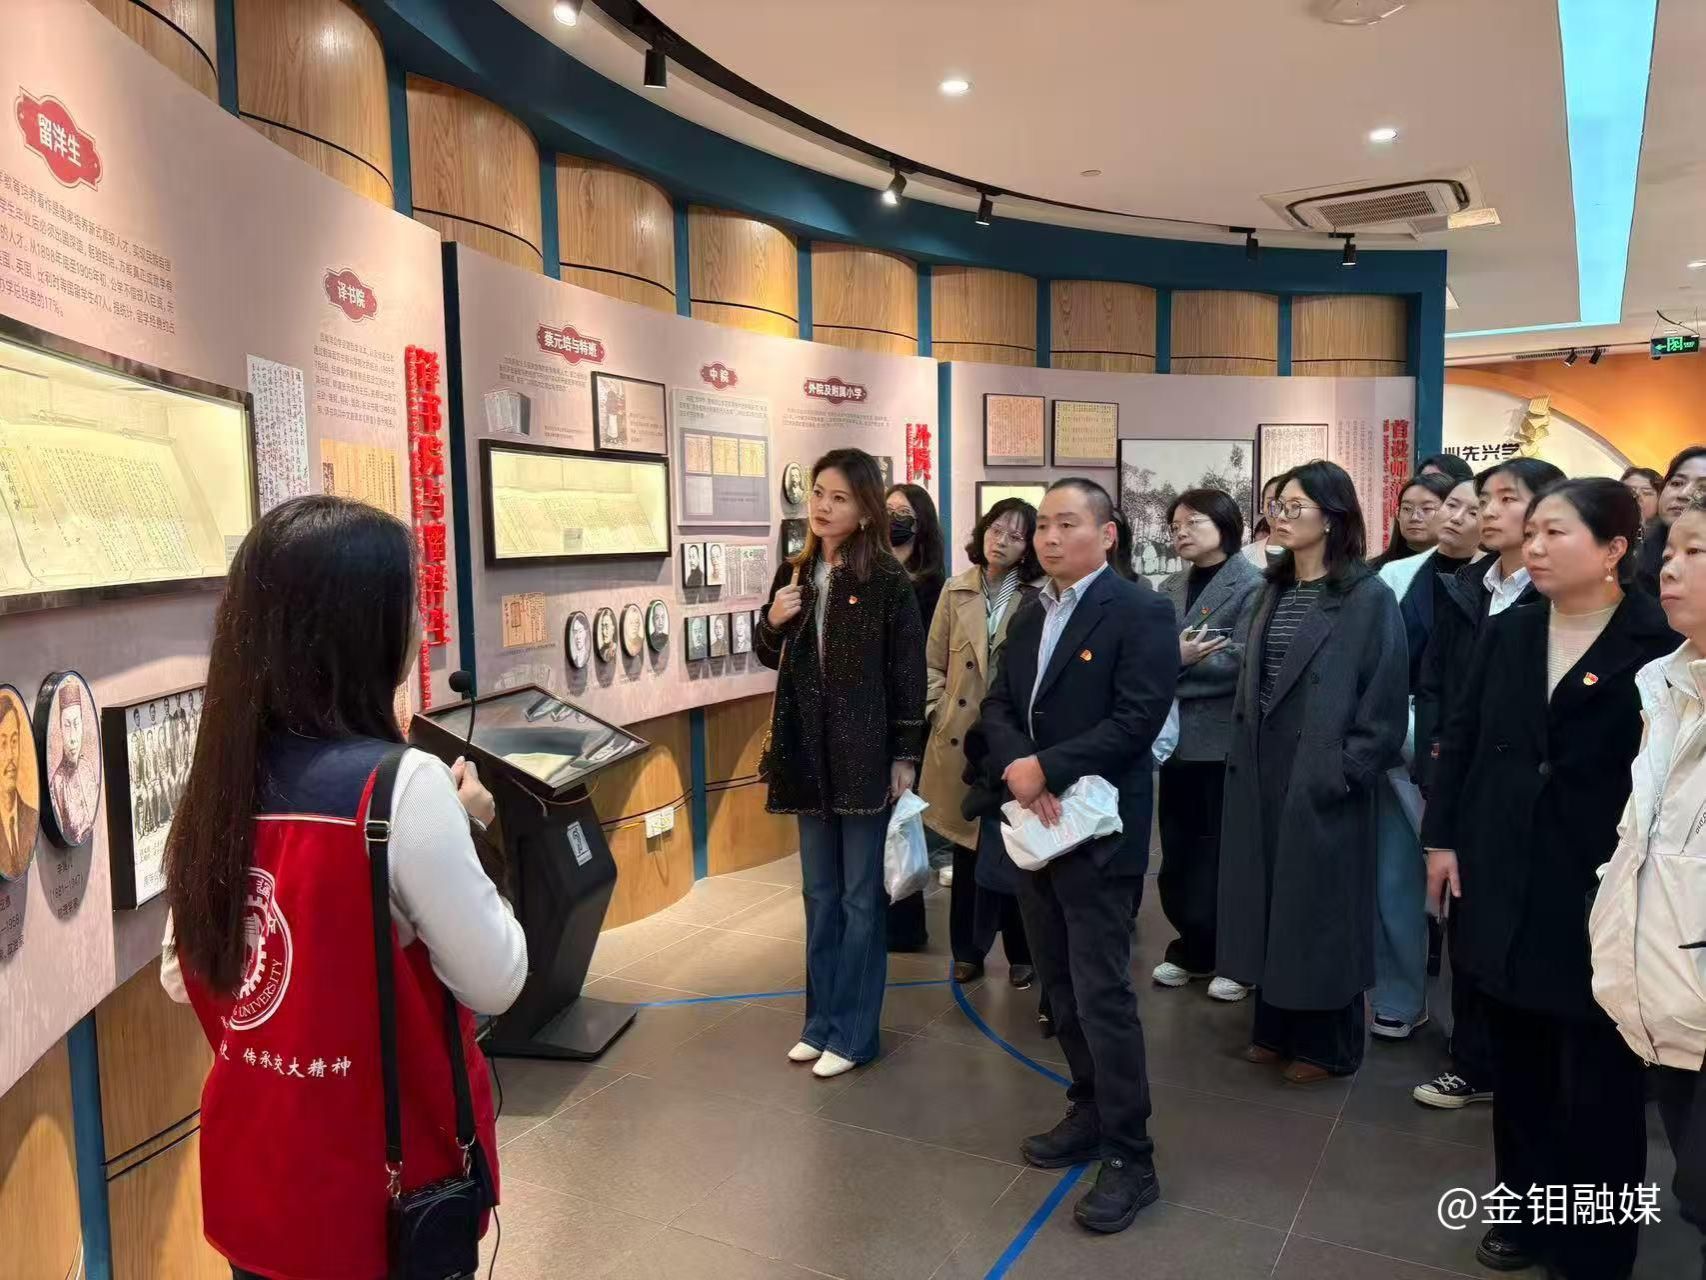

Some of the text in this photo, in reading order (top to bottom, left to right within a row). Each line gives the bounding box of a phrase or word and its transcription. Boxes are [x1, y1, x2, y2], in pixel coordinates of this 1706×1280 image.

[37, 113, 82, 167] 留洋生
[543, 330, 598, 358] 蔡元培与特班
[708, 367, 731, 383] 中院
[238, 958, 285, 1018] UNIVERSITY
[242, 1047, 352, 1078] 传承交大精神
